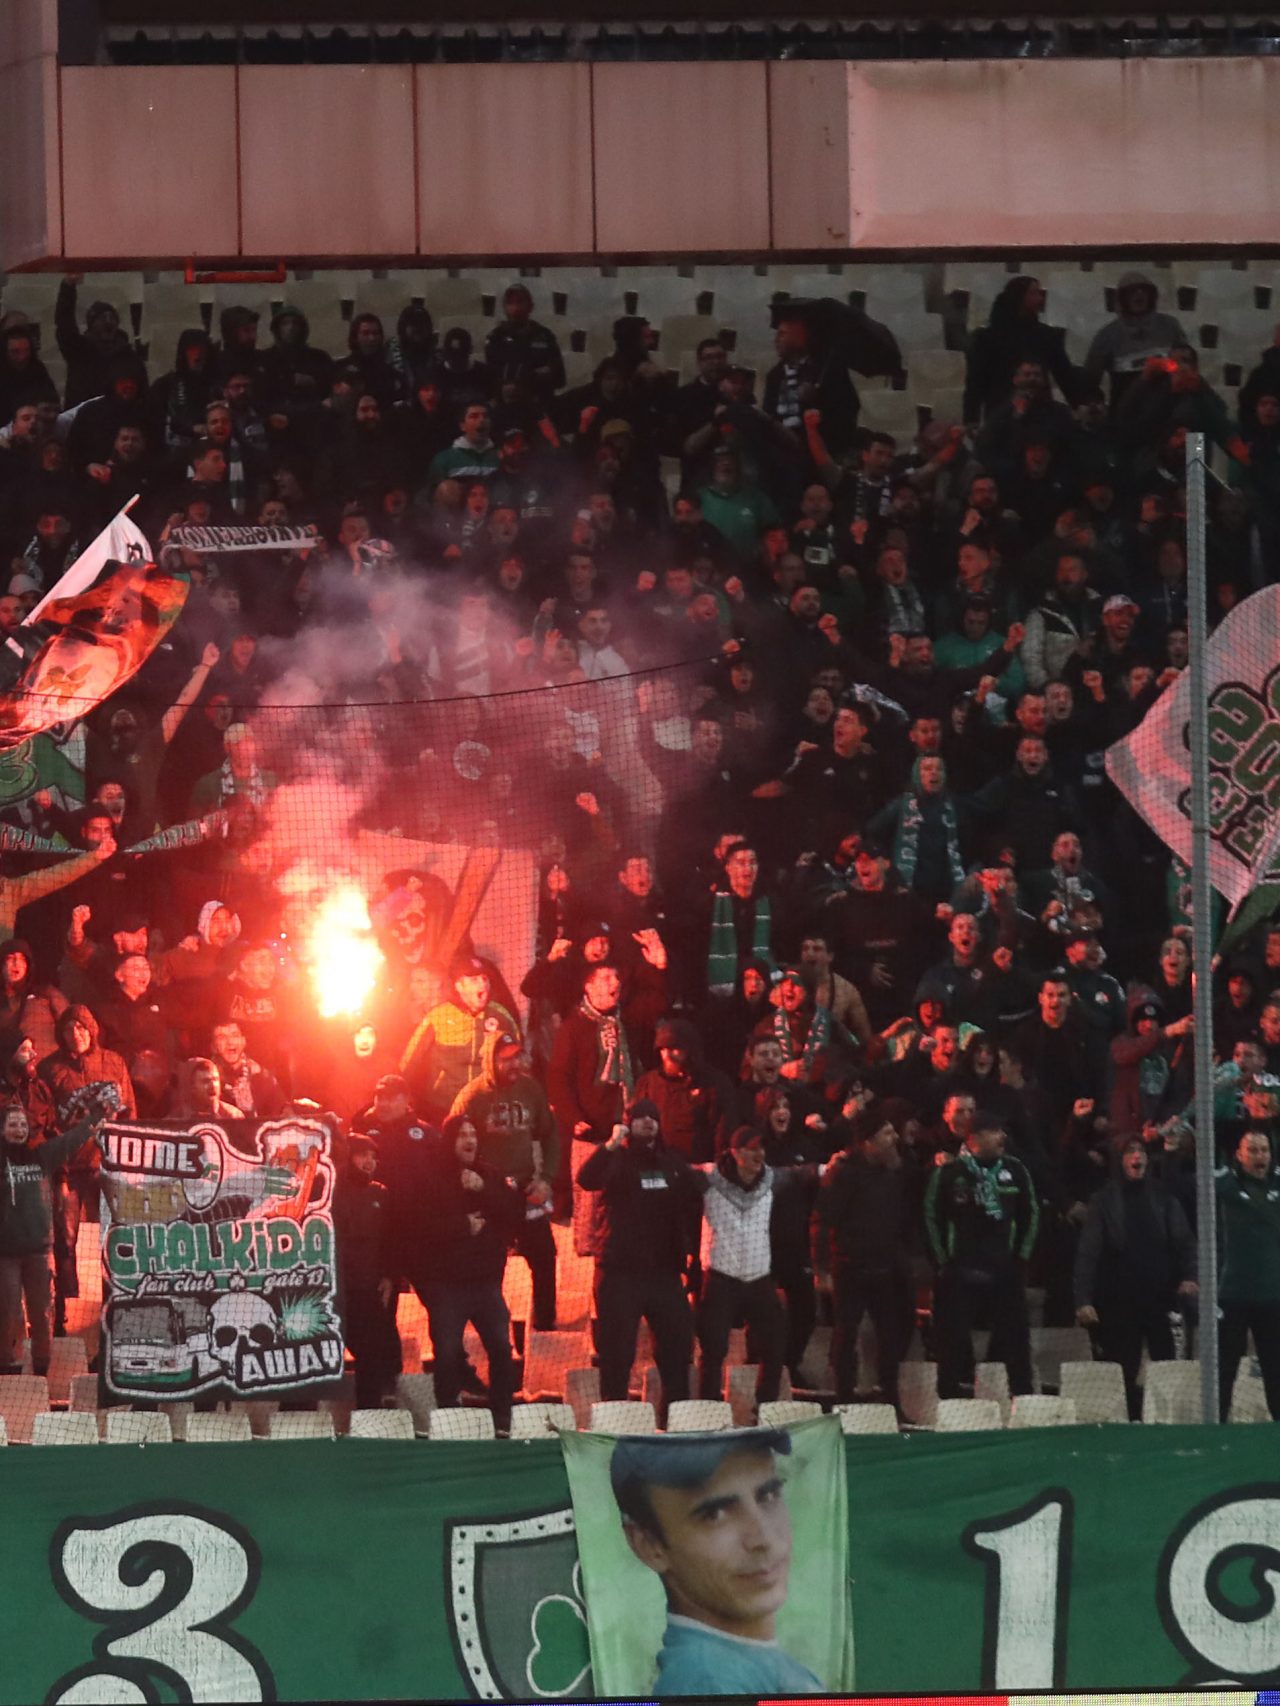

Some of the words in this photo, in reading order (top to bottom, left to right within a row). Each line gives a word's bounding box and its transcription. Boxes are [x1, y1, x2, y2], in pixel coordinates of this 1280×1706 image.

[136, 1275, 169, 1299] fan
[173, 1272, 215, 1292] club
[262, 1273, 304, 1295] gate
[240, 1340, 337, 1384] AWAY
